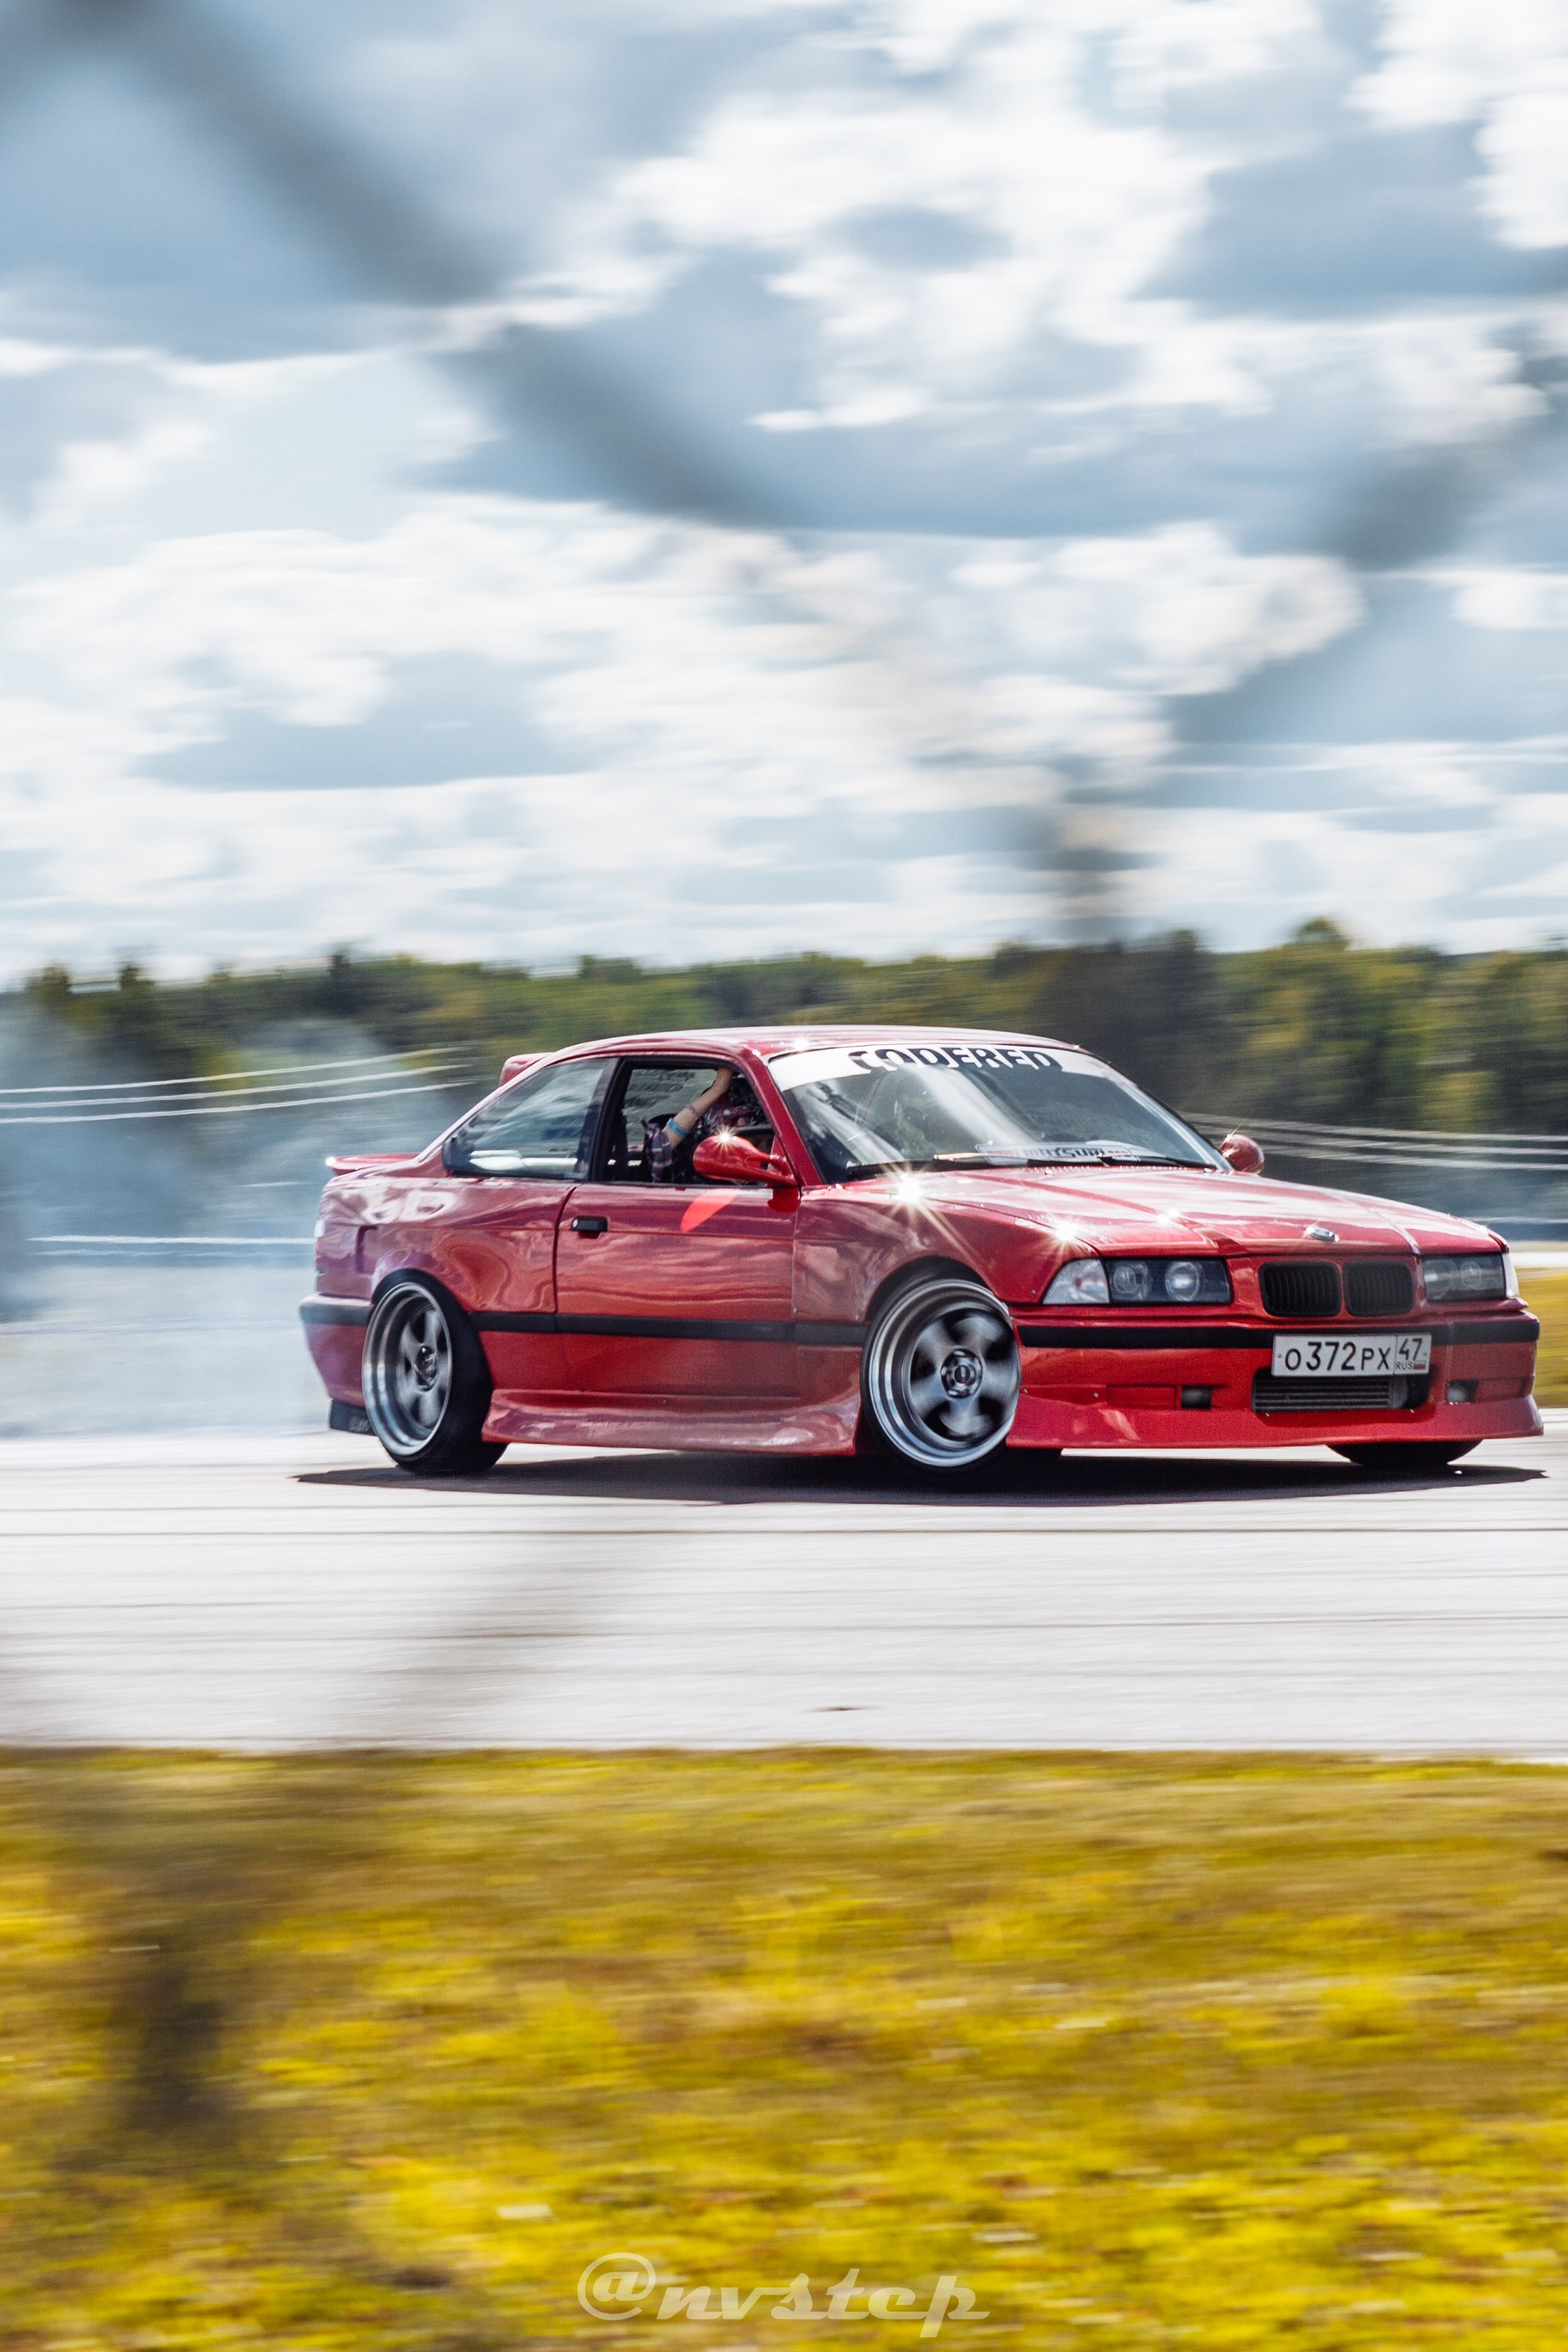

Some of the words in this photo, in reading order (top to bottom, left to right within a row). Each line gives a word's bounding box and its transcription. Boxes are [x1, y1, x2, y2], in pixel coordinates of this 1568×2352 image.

[848, 1047, 1063, 1071] CODERED
[1399, 1338, 1422, 1360] 47
[1395, 1361, 1413, 1370] RUS
